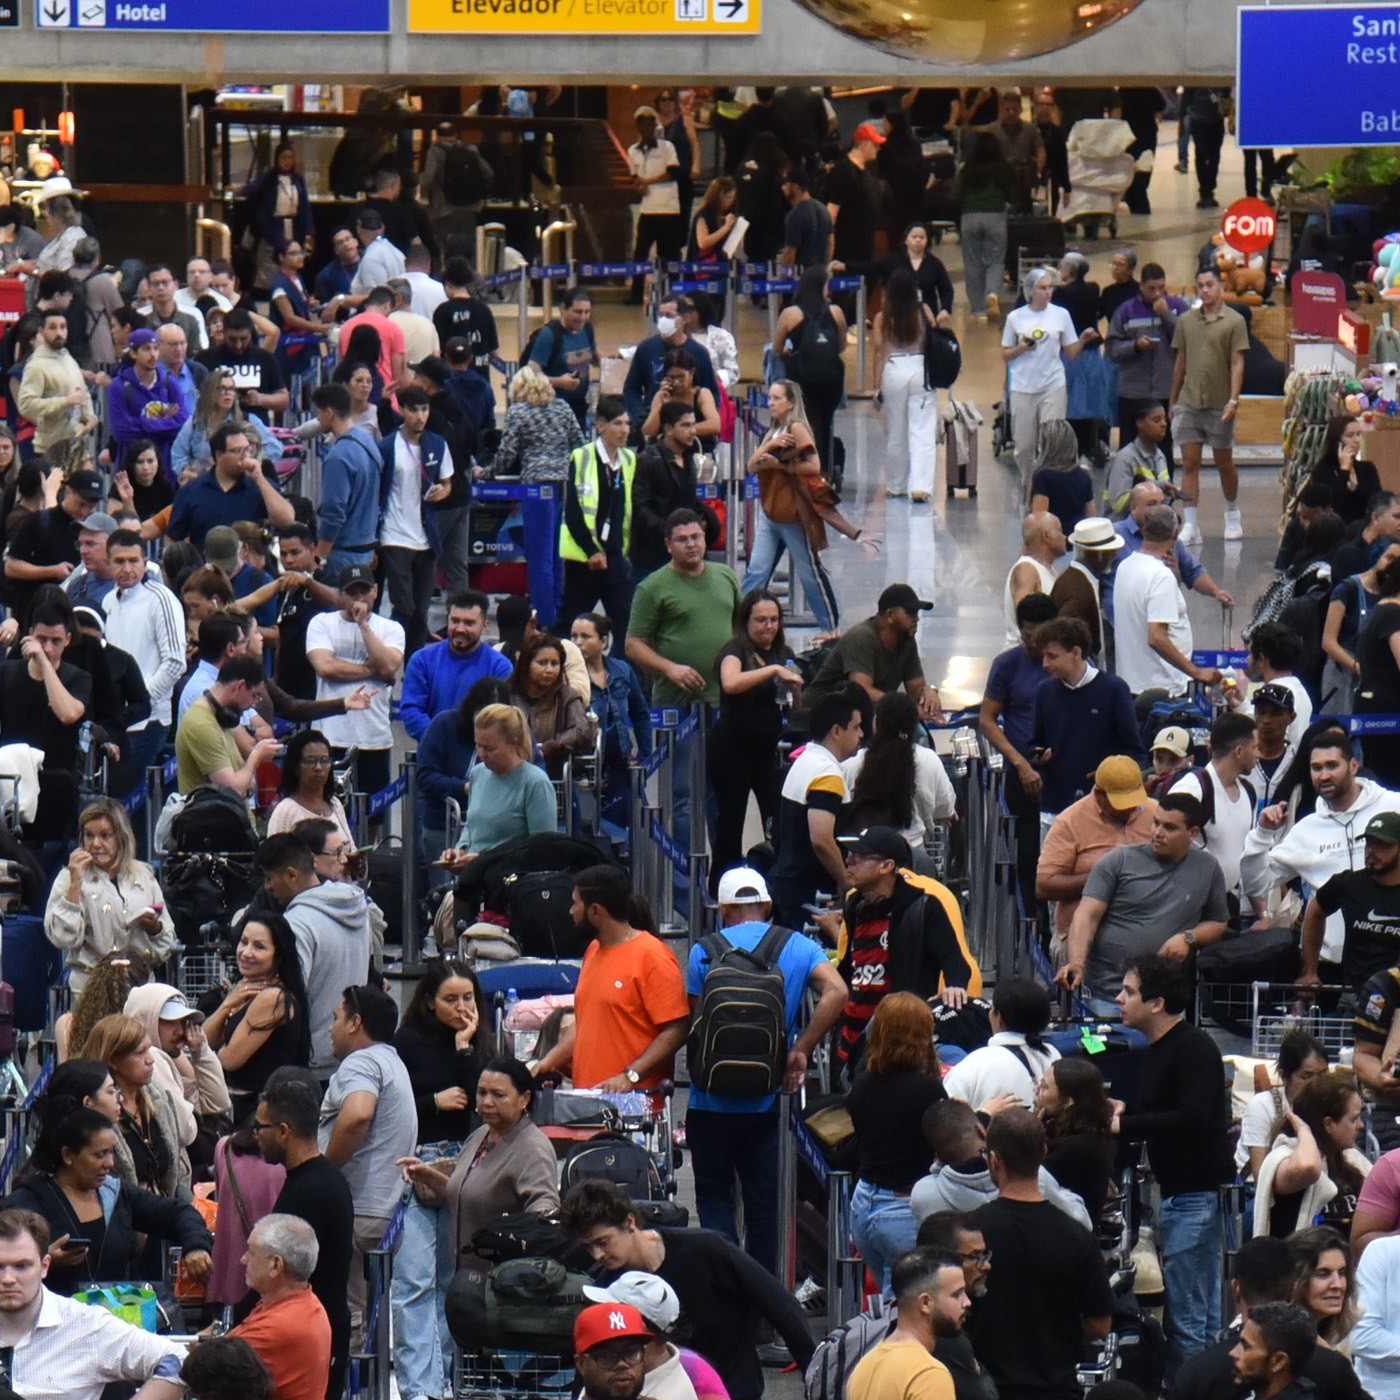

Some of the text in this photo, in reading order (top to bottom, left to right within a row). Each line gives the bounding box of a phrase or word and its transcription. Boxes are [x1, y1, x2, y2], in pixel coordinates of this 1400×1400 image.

[116, 3, 166, 21] Hotel
[451, 0, 560, 14] Elevador
[1224, 215, 1274, 236] FOM
[1353, 919, 1384, 932] NIKE
